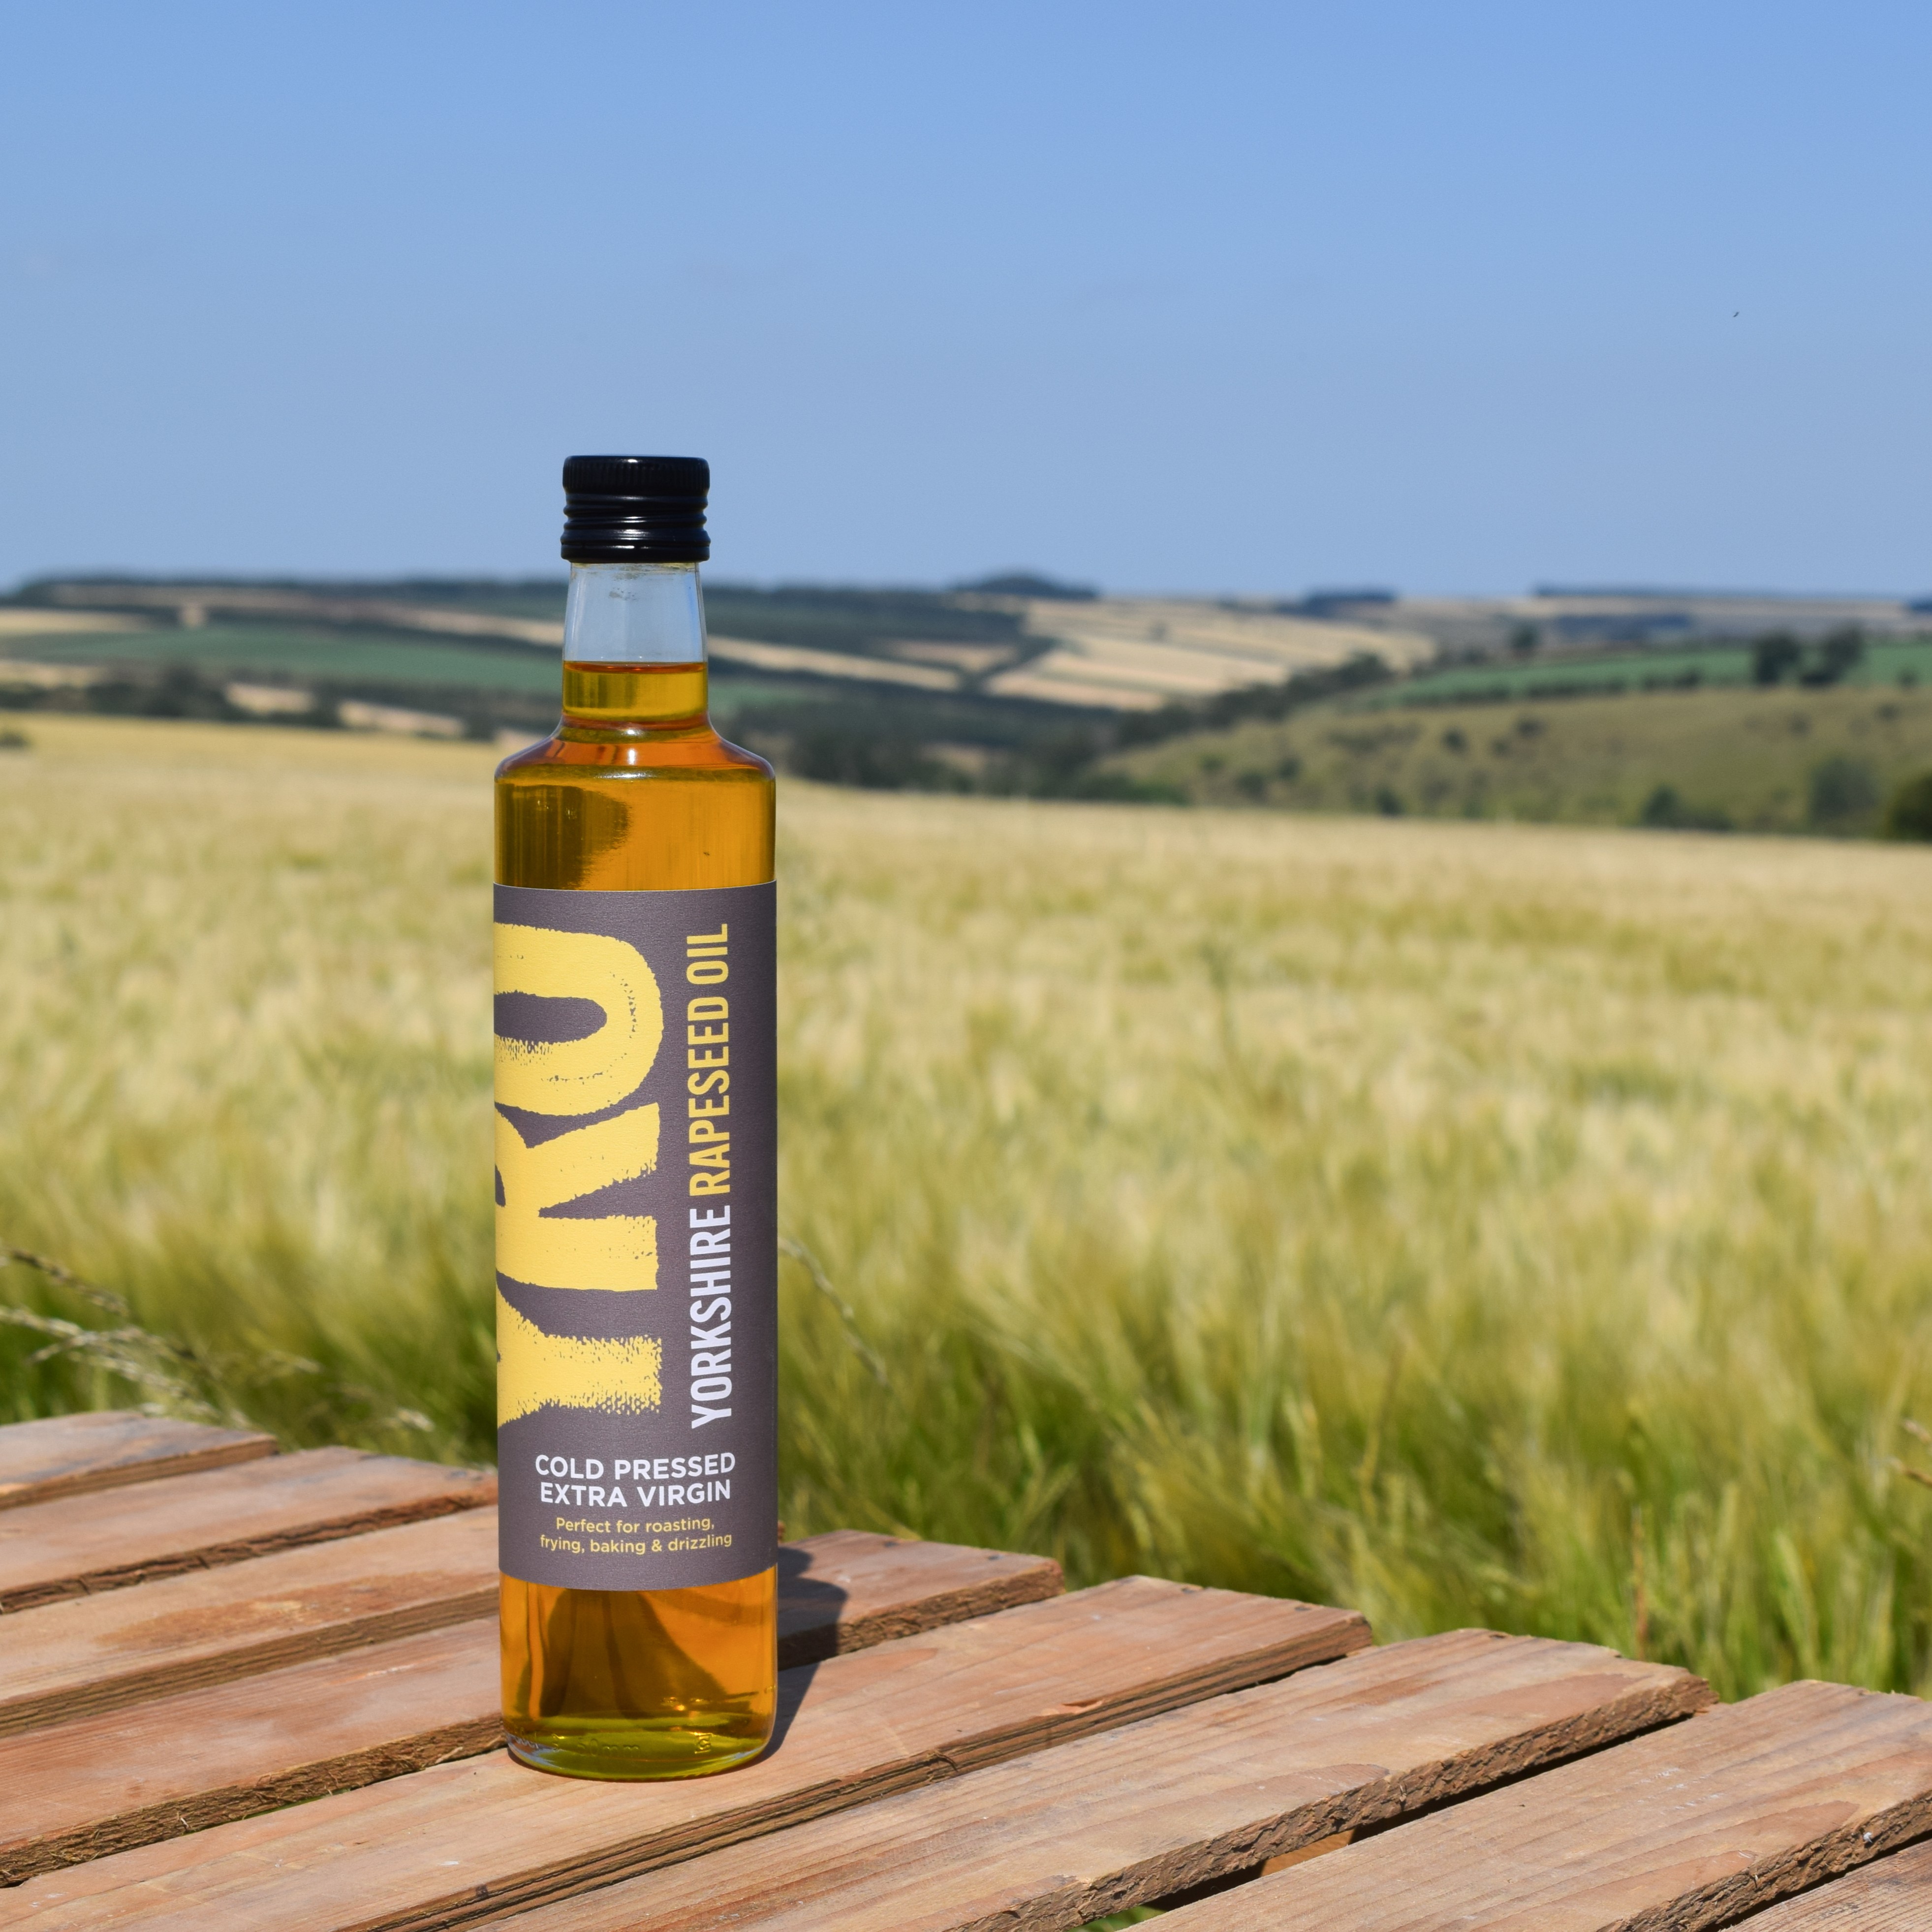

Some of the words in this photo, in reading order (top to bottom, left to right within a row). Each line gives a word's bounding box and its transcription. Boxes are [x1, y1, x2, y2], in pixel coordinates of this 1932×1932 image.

[686, 923, 729, 985] OIL
[687, 997, 730, 1196] RAPESEED
[689, 1205, 732, 1429] YORKSHIRE
[535, 1454, 604, 1479] COLD
[615, 1452, 736, 1480] PRESSED
[541, 1482, 628, 1507] EXTRA
[637, 1479, 731, 1507] VIRGIN
[556, 1517, 611, 1533] Perfect
[617, 1519, 640, 1533] for
[646, 1518, 715, 1533] roasting,
[540, 1534, 585, 1554] frying,
[590, 1540, 646, 1555] baking
[651, 1539, 662, 1553] &
[668, 1533, 732, 1552] drizzling
